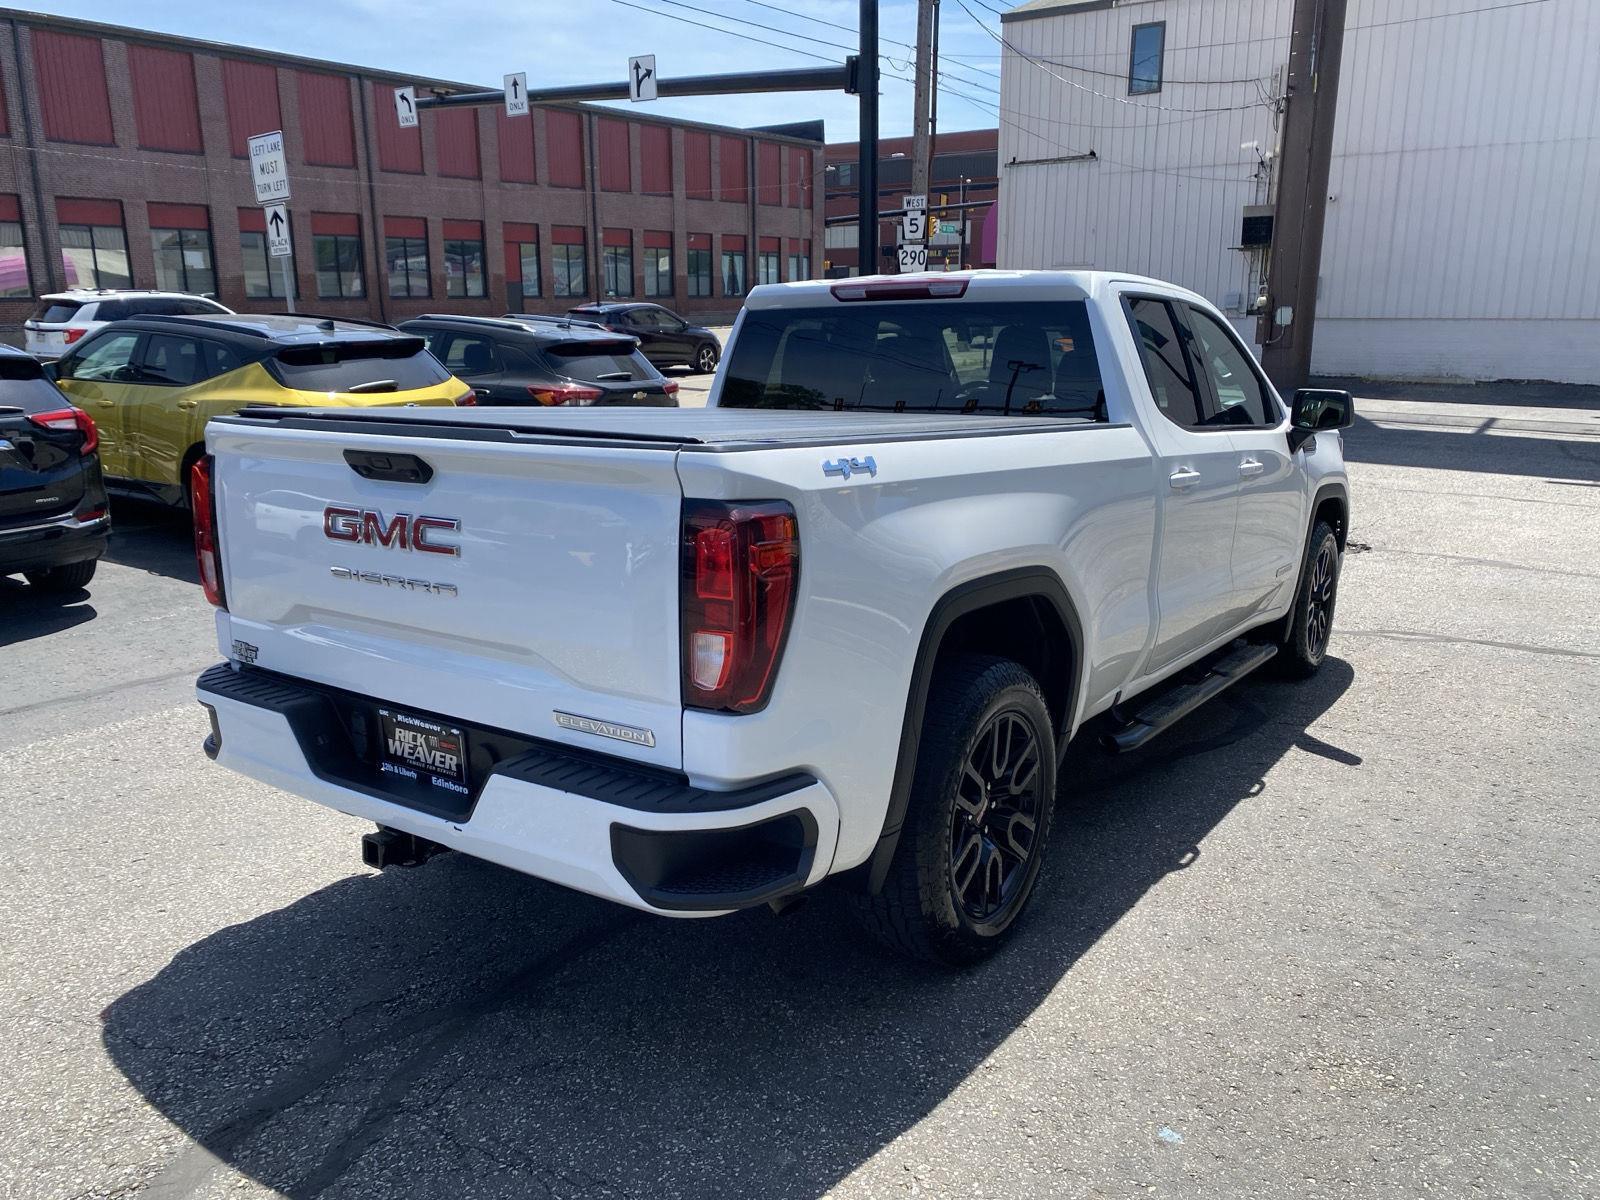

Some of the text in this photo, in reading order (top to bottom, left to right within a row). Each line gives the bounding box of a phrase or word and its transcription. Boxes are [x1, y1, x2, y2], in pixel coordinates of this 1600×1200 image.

[509, 102, 525, 112] ONLY
[400, 114, 415, 124] ONLY
[252, 140, 281, 157] LEFT LANE
[260, 160, 279, 175] MUST
[257, 179, 286, 195] TURN LEFT
[905, 197, 925, 208] WEST
[909, 217, 919, 233] 5
[271, 238, 288, 248] BLACK
[901, 250, 926, 266] 290
[323, 505, 461, 558] GMC
[330, 566, 459, 597] SIERRA
[395, 727, 426, 746] RICK
[559, 716, 646, 742] ELEVATION
[388, 738, 457, 771] WEAVER
[399, 767, 417, 780] Liberty
[431, 776, 469, 794] Edinboro
